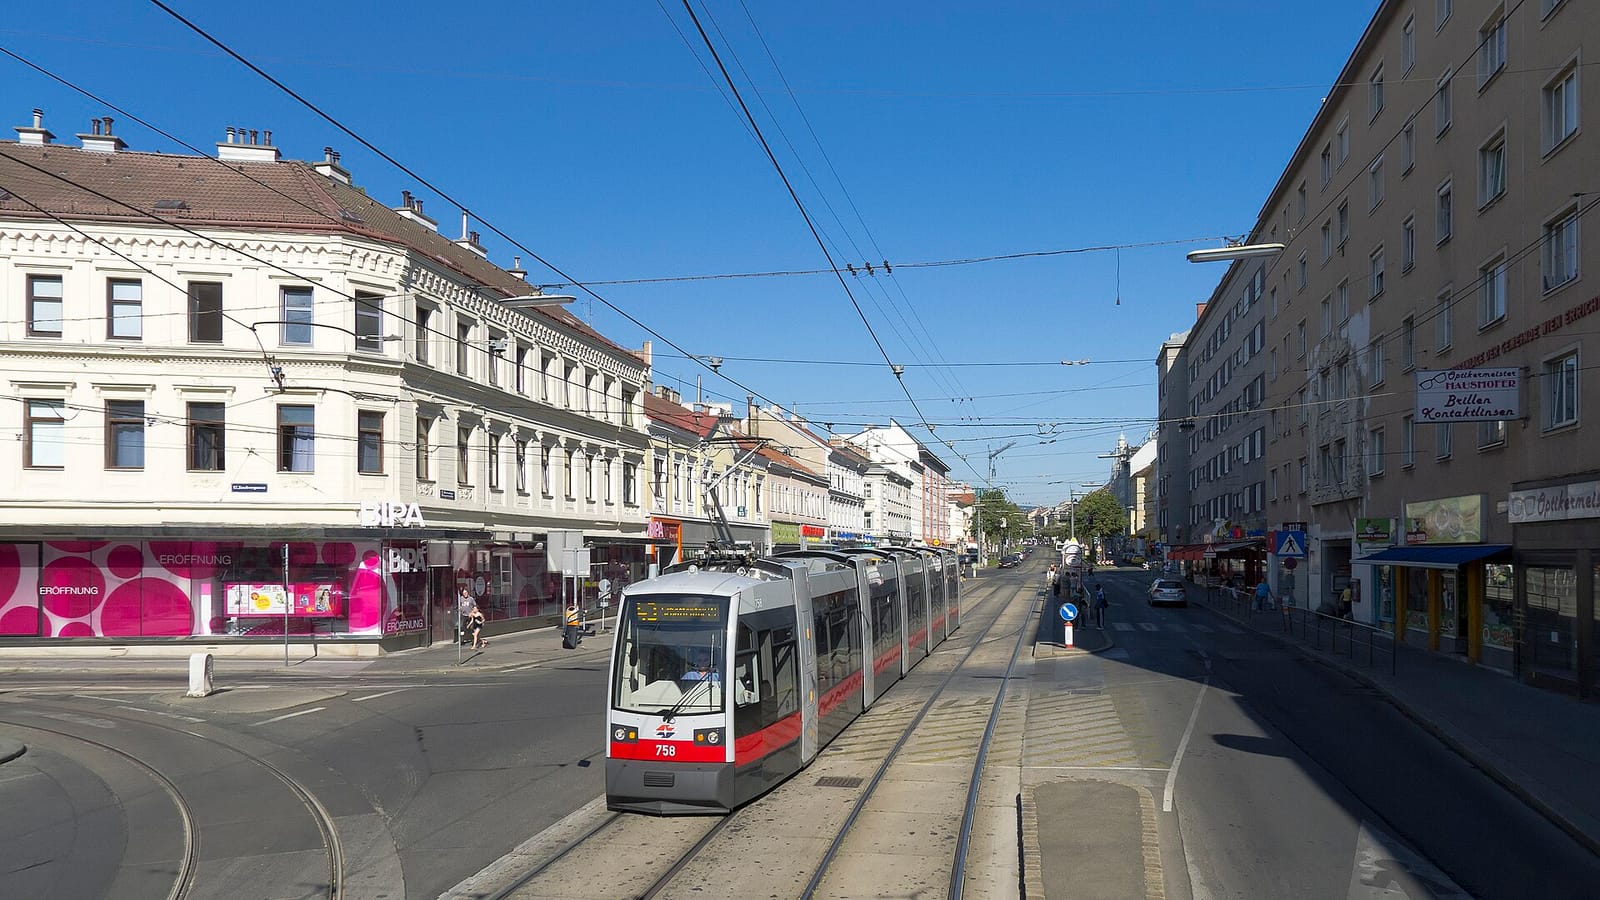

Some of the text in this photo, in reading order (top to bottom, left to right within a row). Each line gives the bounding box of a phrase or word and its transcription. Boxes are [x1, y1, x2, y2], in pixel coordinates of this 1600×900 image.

[1447, 370, 1516, 382] Optikermeister
[1445, 380, 1516, 390] HAUSHOFER
[1444, 394, 1492, 407] Brillen
[1422, 406, 1515, 420] Kontaktlinsen
[361, 501, 426, 528] BIPA
[159, 553, 232, 565] ERÖFFNUNG
[389, 548, 427, 573] BIPA
[39, 586, 99, 595] ERÖFFNUNG
[655, 744, 676, 757] 758
